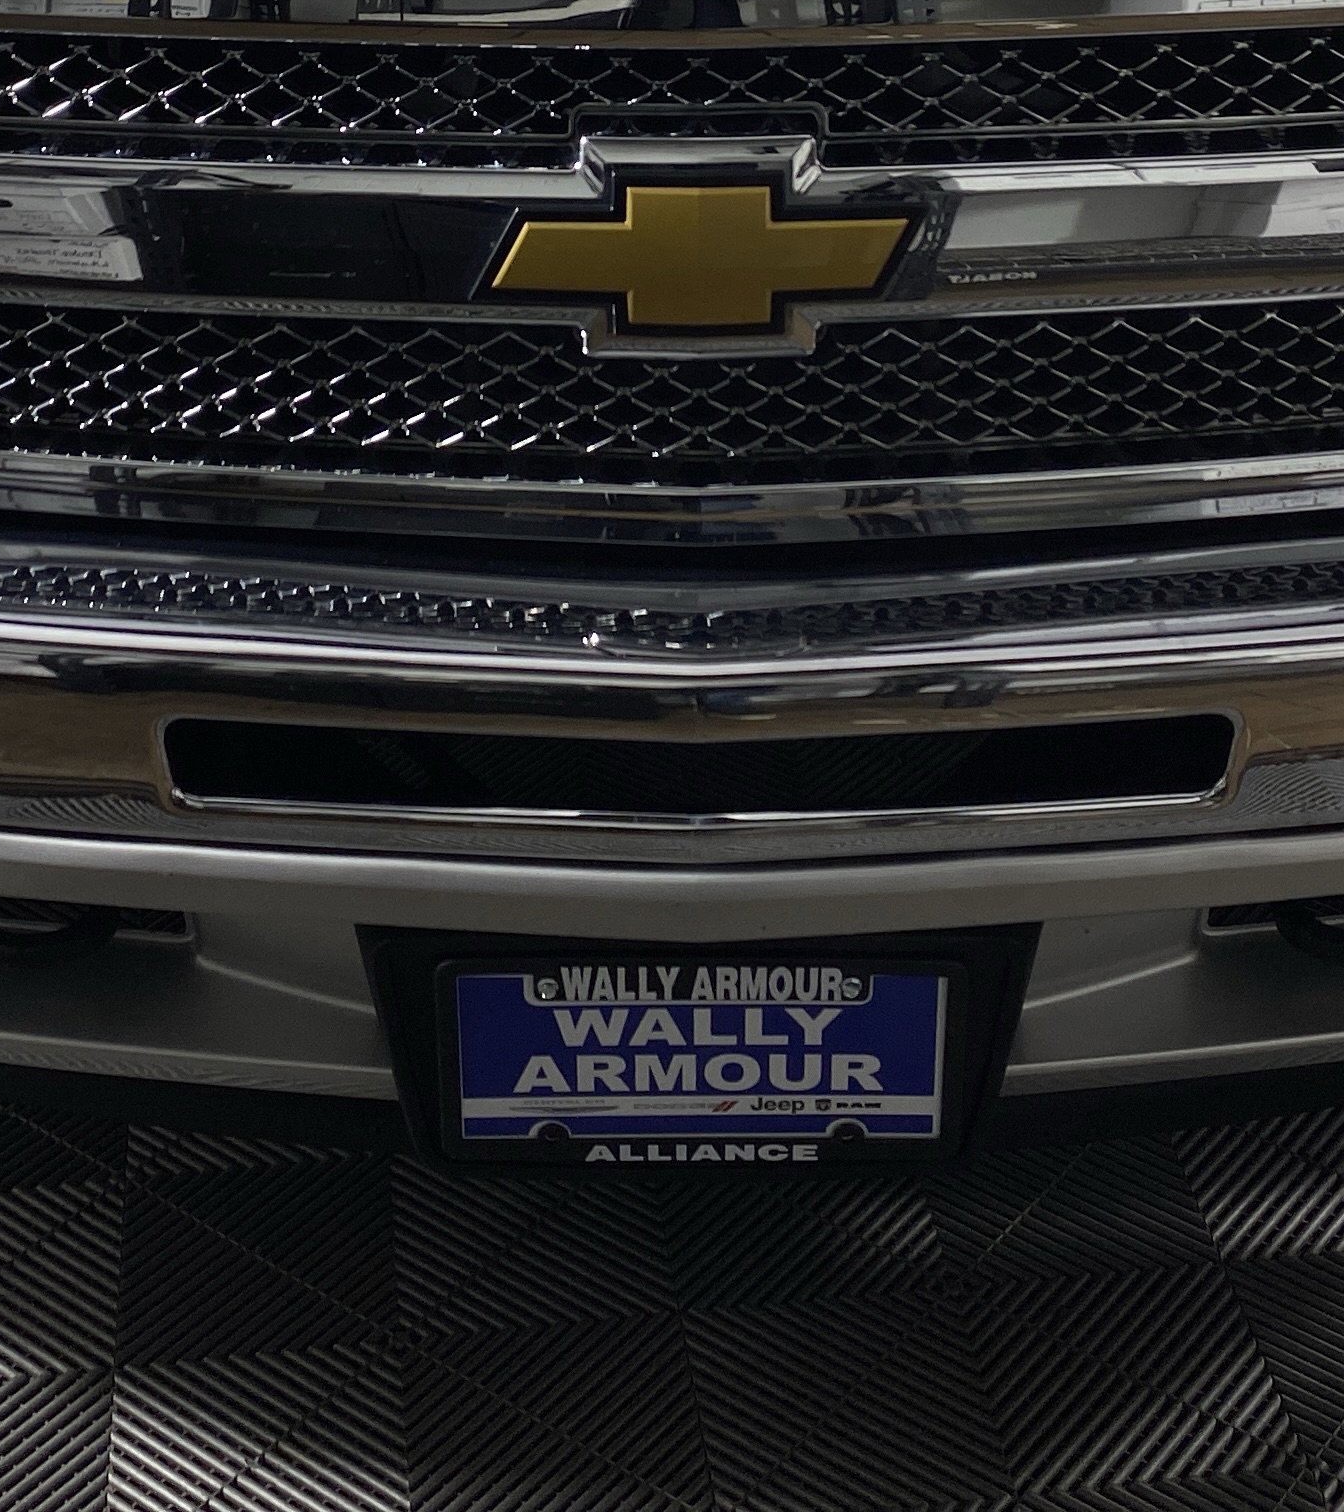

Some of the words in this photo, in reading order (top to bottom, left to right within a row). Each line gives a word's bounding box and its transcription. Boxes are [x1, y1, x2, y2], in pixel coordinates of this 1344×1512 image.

[560, 966, 680, 1001] WALLY
[691, 966, 844, 1001] ARMOUR
[553, 1007, 844, 1047] WALLY
[513, 1053, 884, 1093] ARMOUR
[751, 1097, 805, 1114] Jeep
[585, 1144, 819, 1162] ALLIANCE
